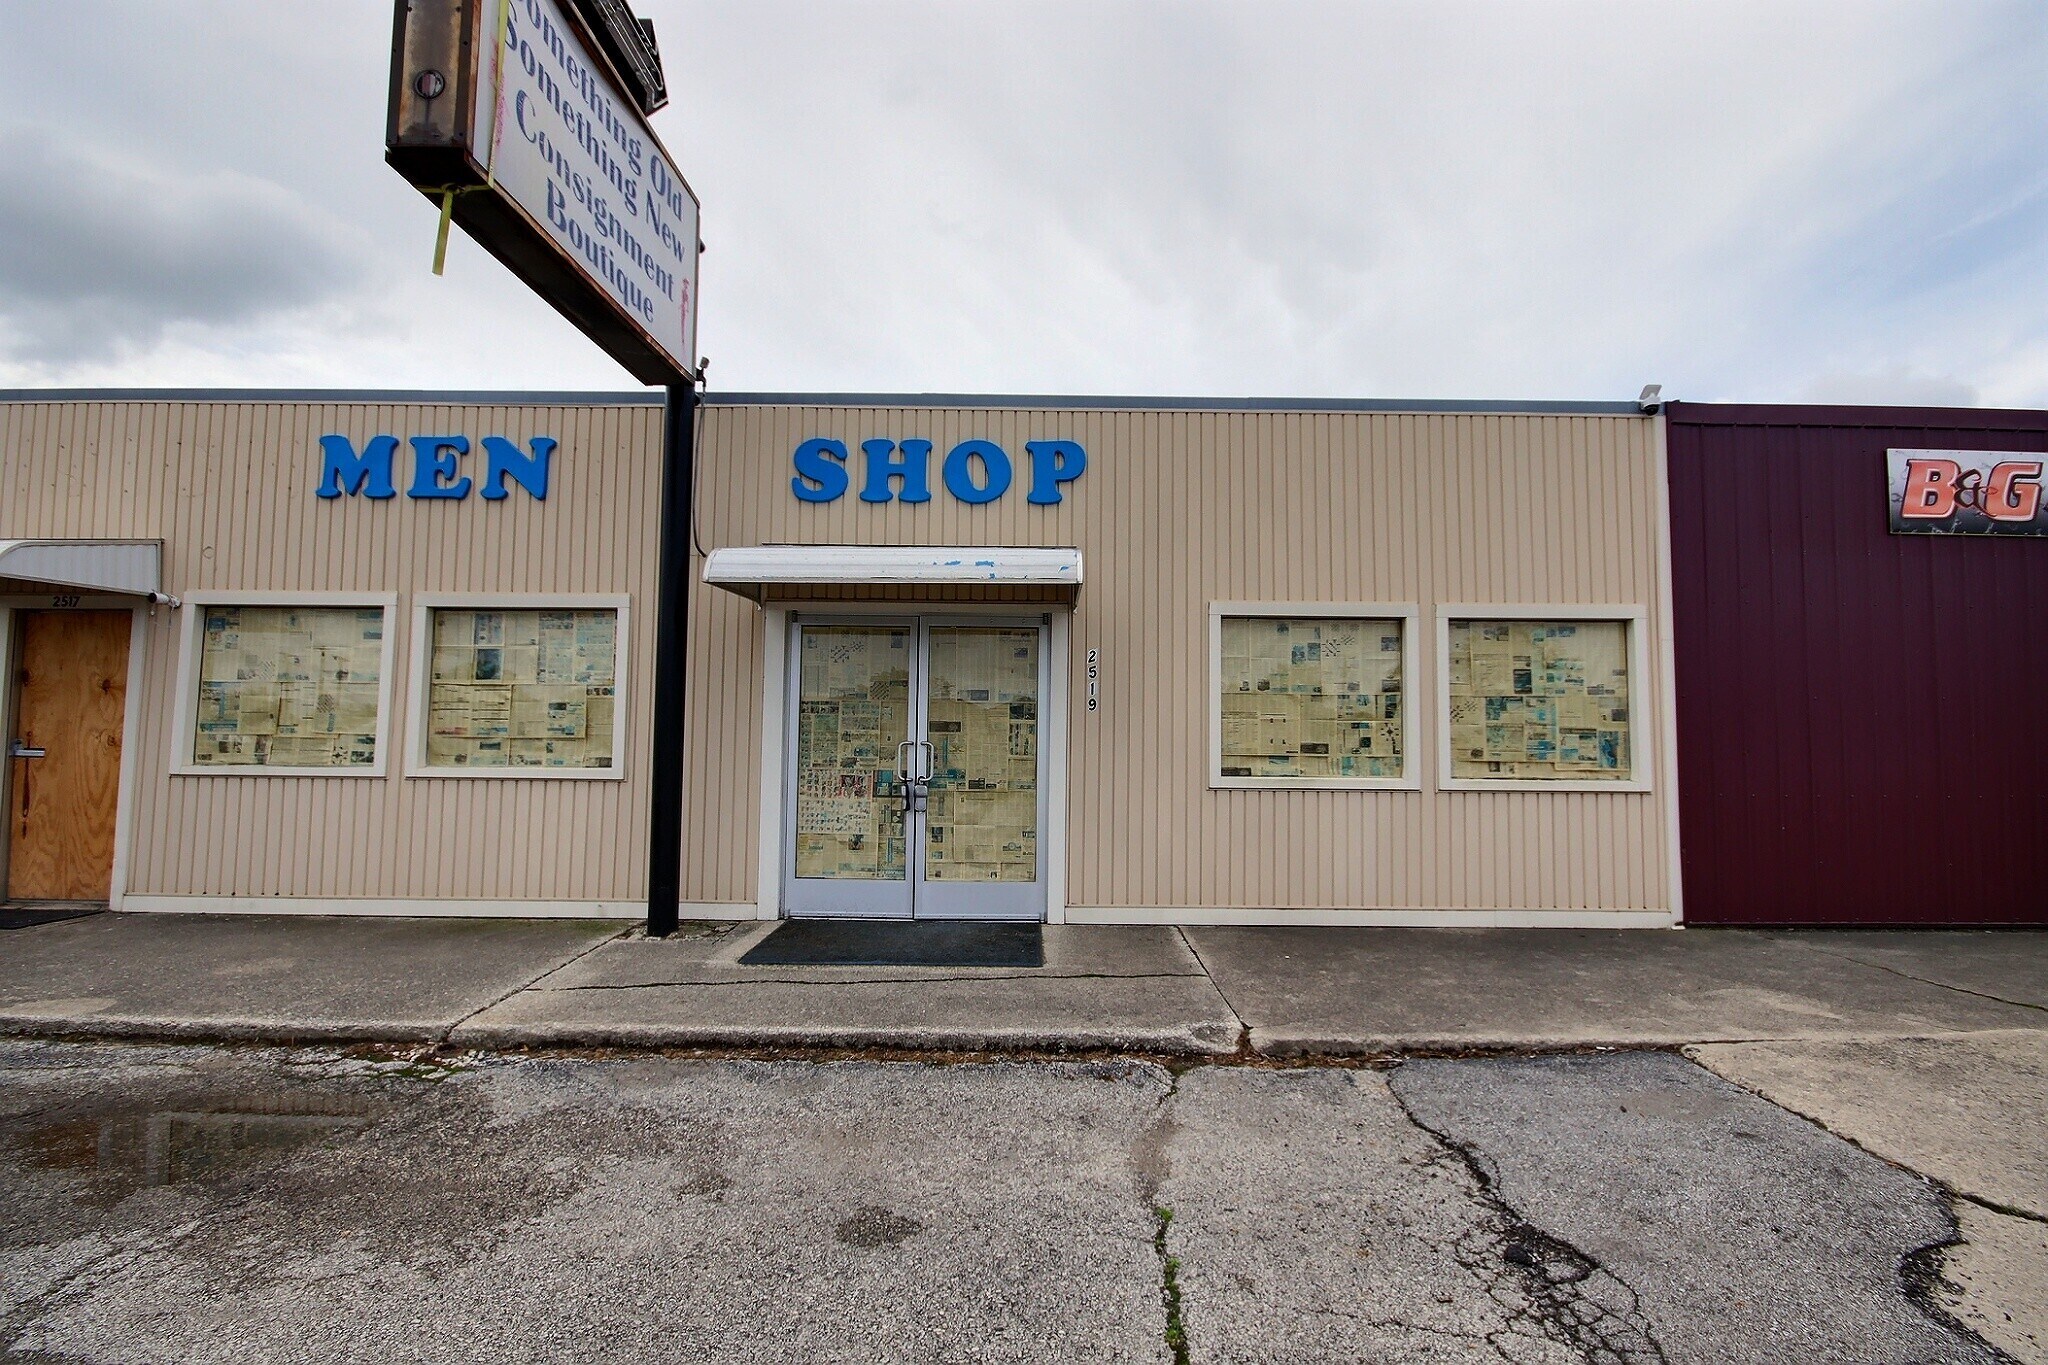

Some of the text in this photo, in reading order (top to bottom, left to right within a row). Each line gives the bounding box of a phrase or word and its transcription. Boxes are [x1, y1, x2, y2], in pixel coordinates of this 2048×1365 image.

[519, 0, 682, 222] omething Old
[516, 89, 675, 303] Consignment
[646, 189, 685, 263] New
[546, 176, 655, 324] Boutique
[315, 434, 1088, 506] MEN SHOP
[1901, 458, 2044, 523] B&G
[52, 595, 81, 608] 2517
[1087, 649, 1098, 712] 2519
